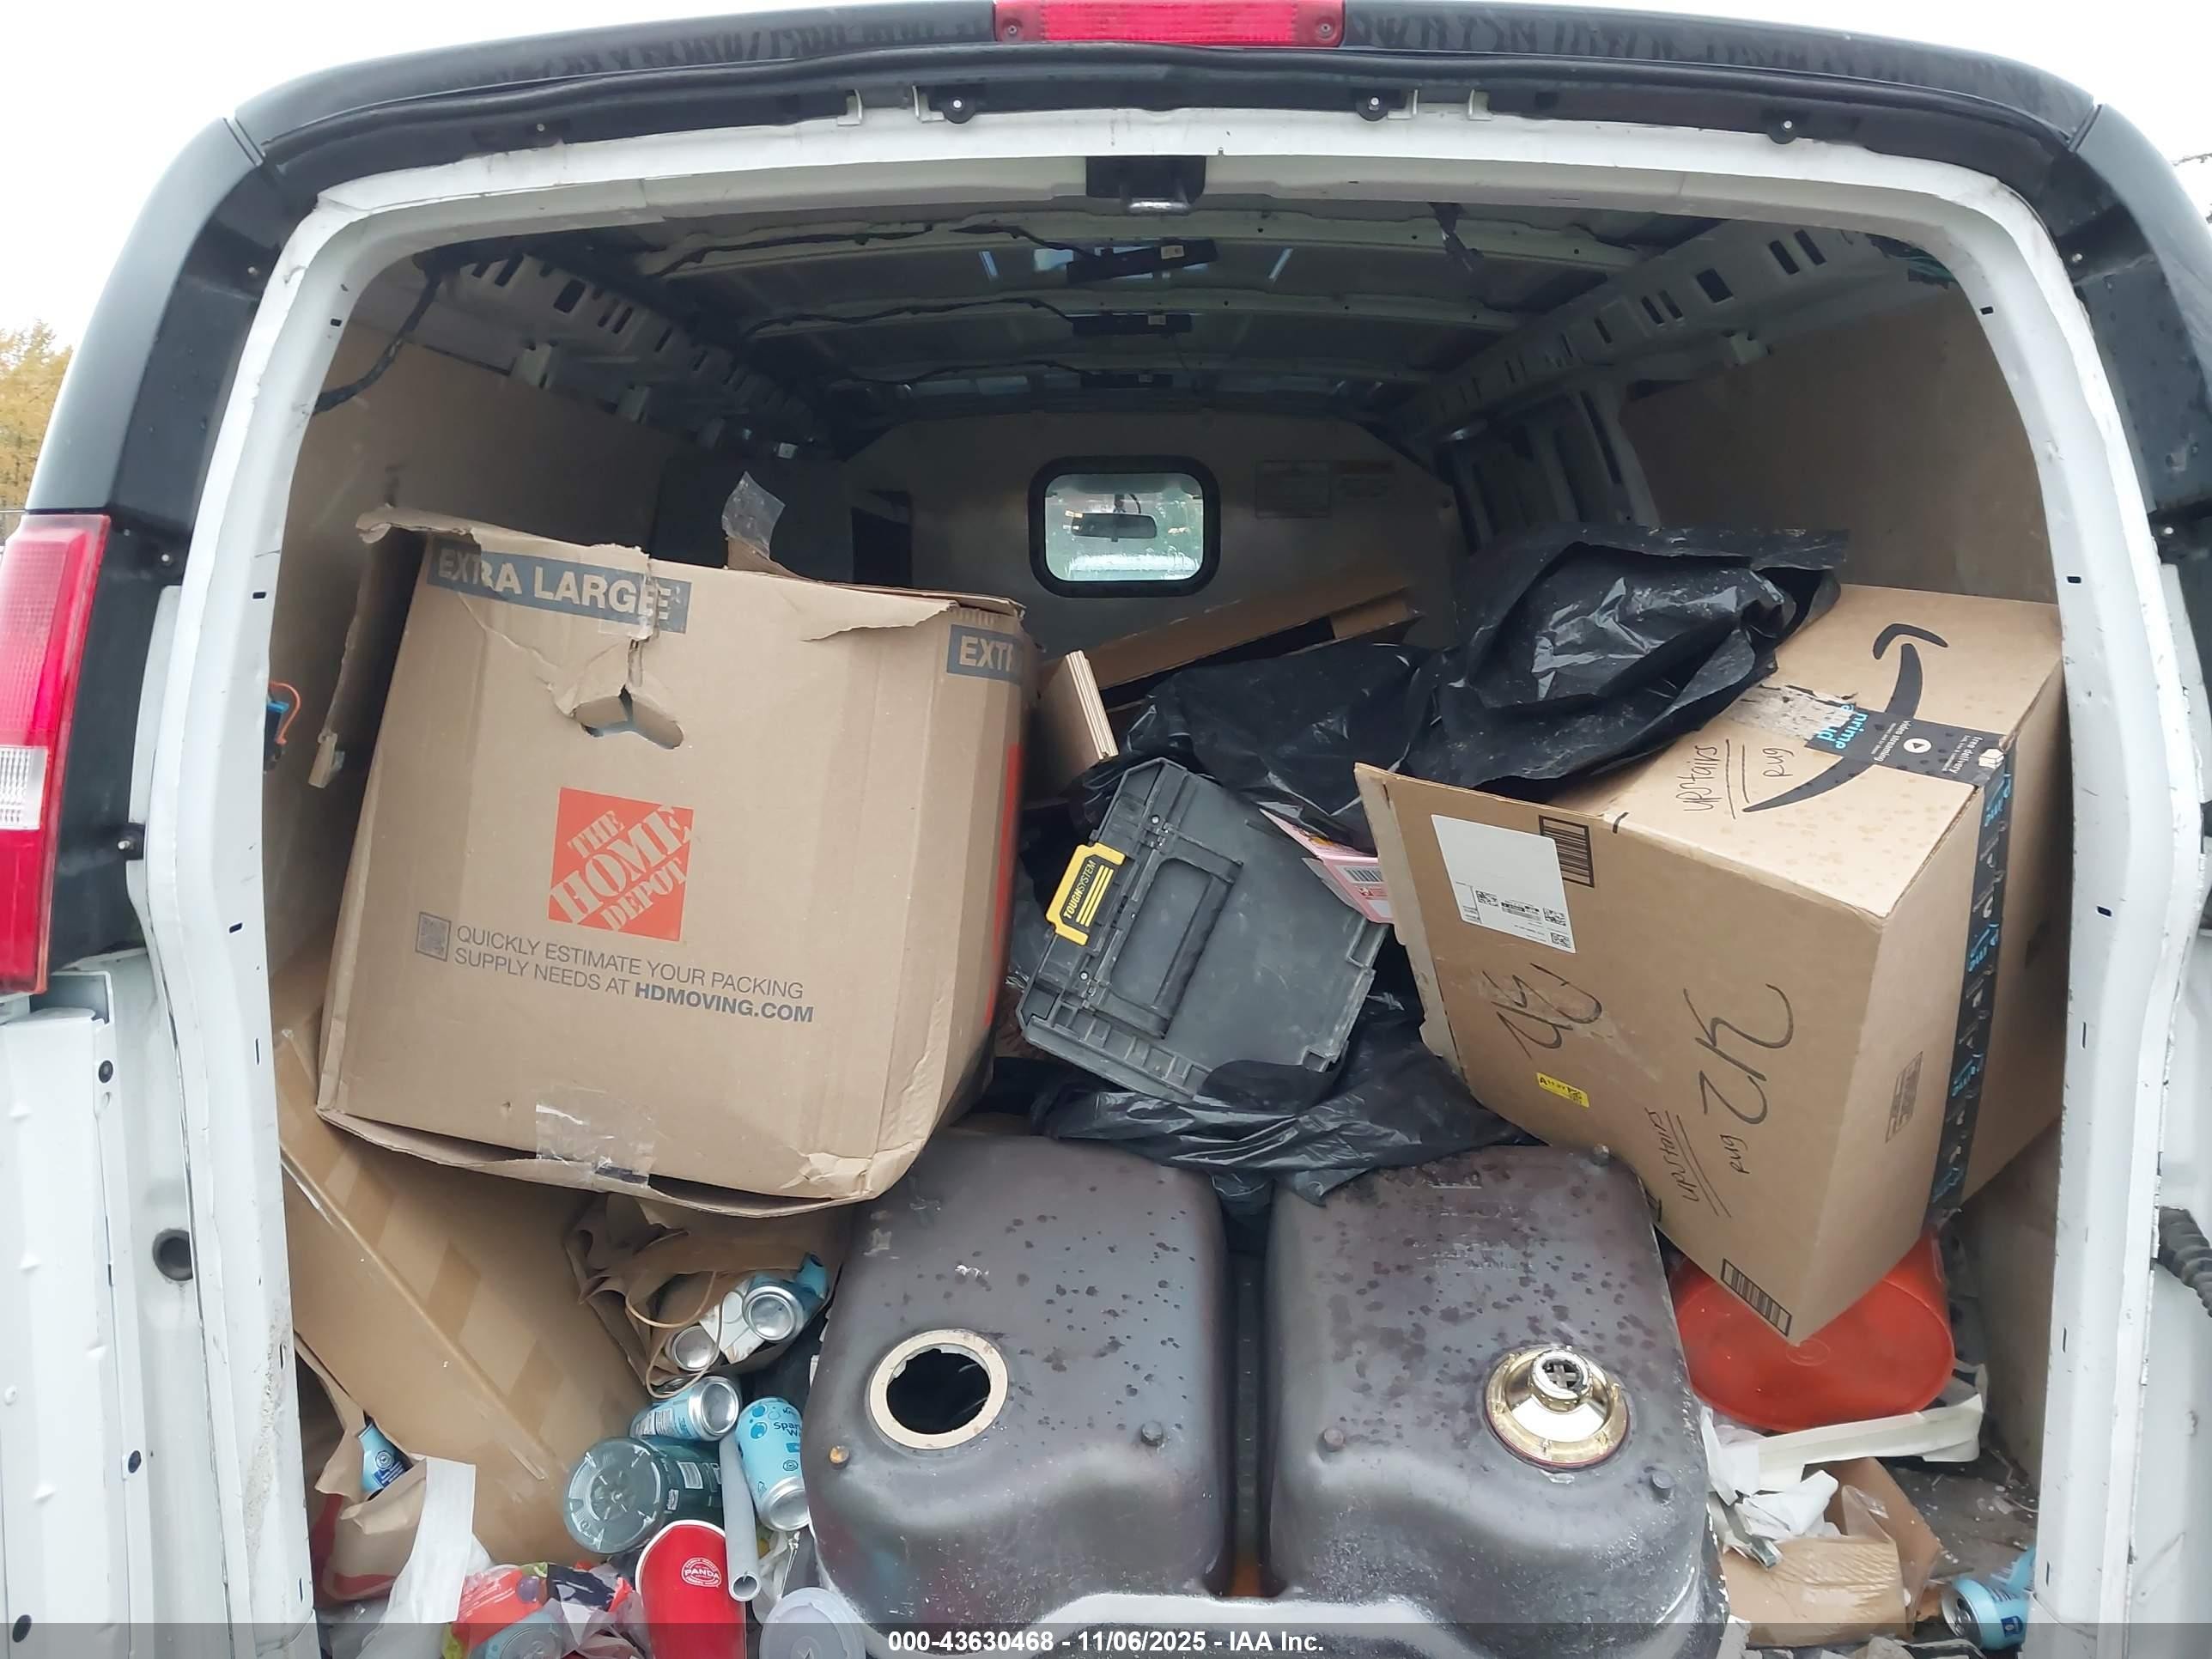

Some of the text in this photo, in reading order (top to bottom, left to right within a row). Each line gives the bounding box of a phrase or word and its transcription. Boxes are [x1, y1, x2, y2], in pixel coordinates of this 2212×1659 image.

[438, 548, 672, 621] EXTRA LARGE
[550, 805, 692, 924] HOME
[567, 810, 625, 859] THE
[600, 857, 688, 931] DEPOT
[1062, 860, 1097, 920] TOUGHSYSTEM
[454, 947, 814, 1024] SUPPLY NEEDS AT HDMOVING.COM
[456, 925, 805, 1000] QUICKLY ESTIMATE YOUR PACKING
[684, 1568, 721, 1580] PANDA
